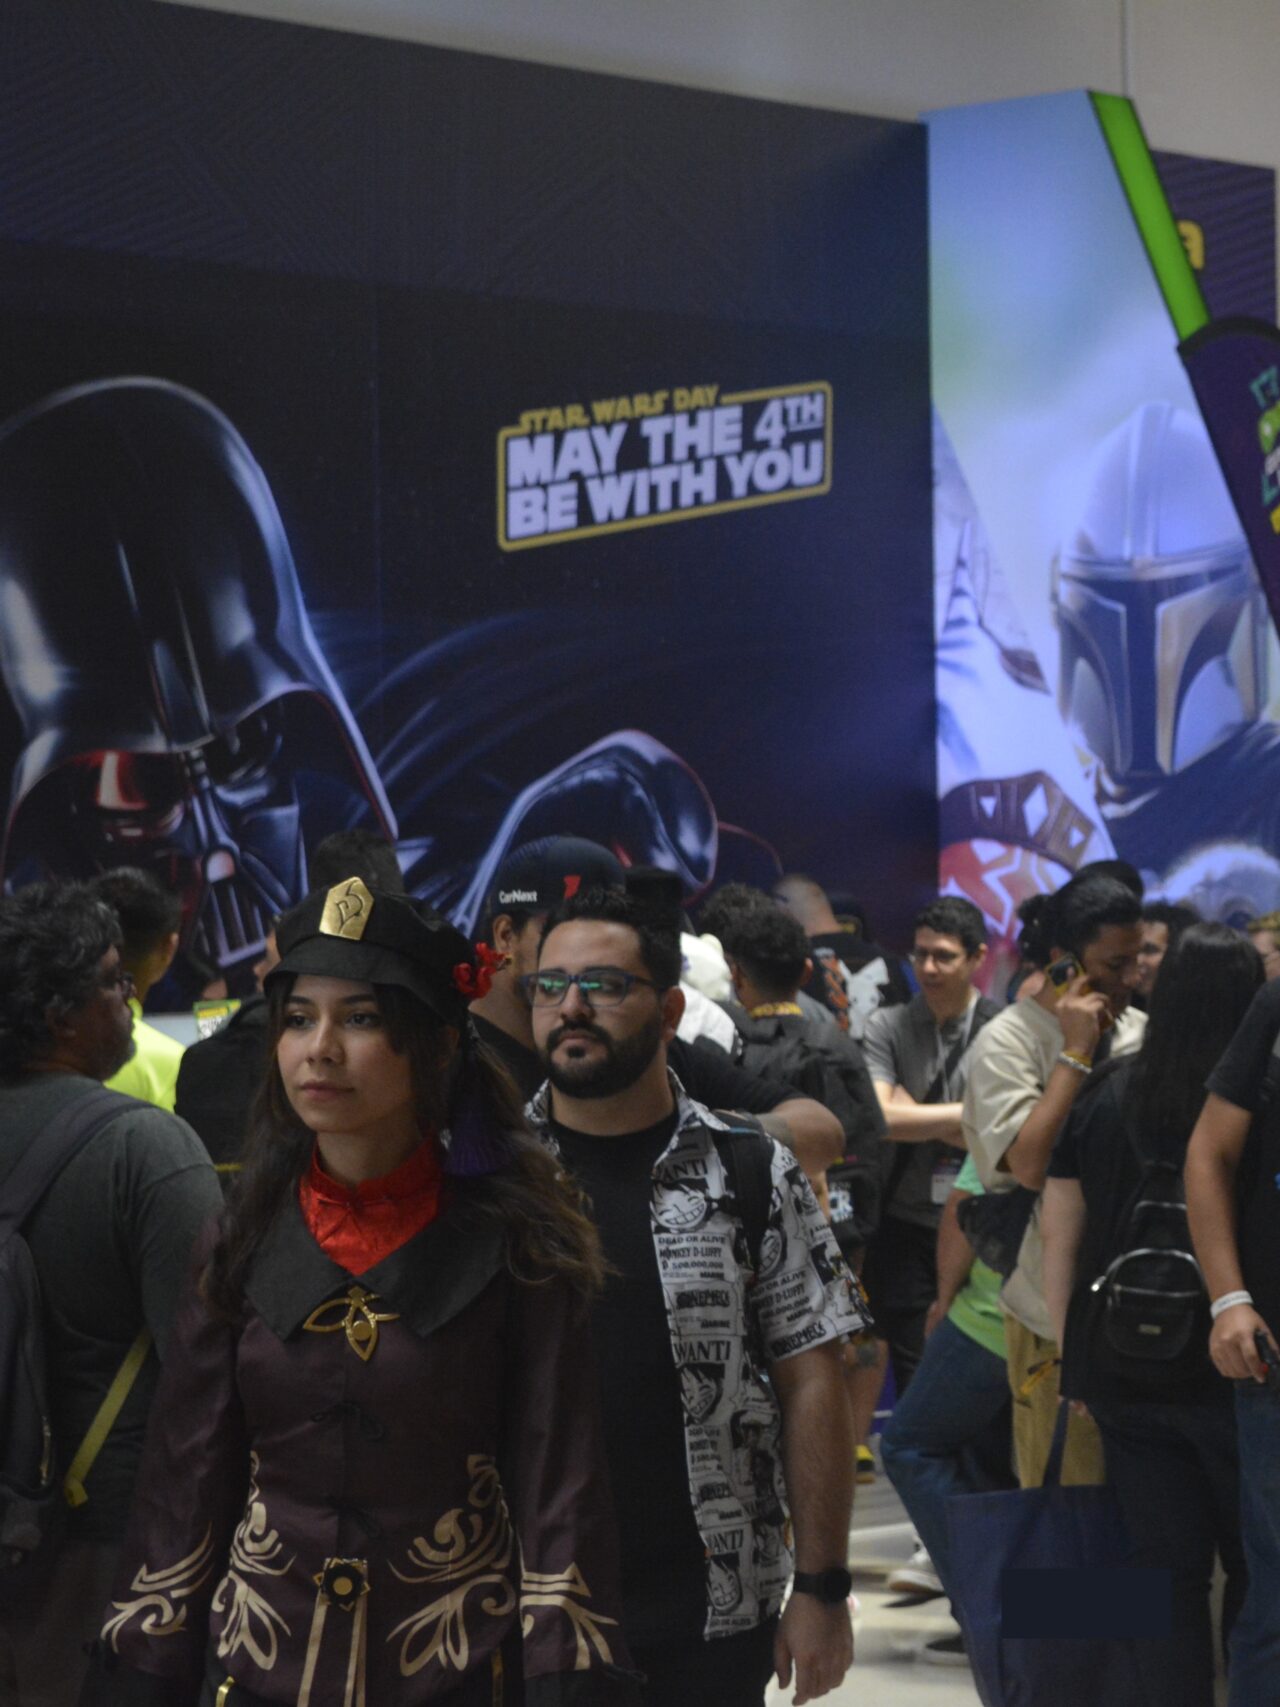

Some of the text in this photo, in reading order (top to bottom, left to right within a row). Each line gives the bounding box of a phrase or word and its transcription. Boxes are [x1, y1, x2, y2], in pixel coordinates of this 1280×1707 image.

[506, 392, 825, 489] MAY THE 4TH
[519, 384, 720, 433] STAR WARS DAY
[506, 439, 825, 540] BE WITH YOU
[499, 888, 538, 904] CarNext
